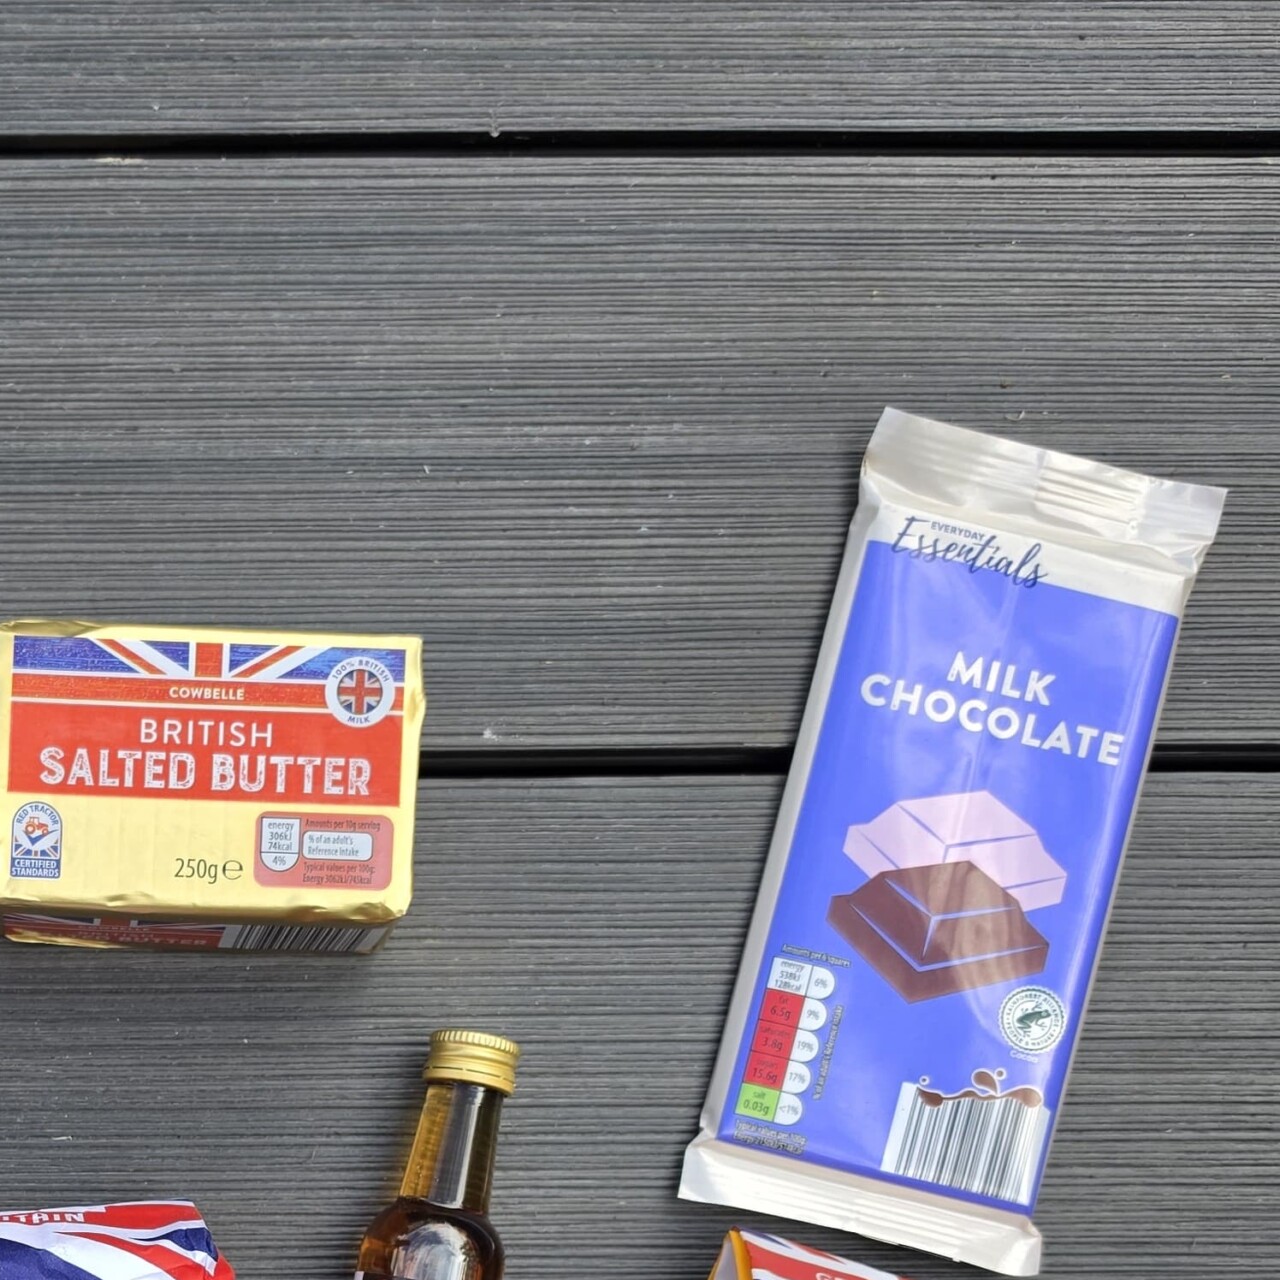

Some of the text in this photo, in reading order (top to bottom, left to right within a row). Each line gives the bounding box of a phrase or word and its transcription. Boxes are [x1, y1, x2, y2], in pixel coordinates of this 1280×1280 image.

[930, 521, 985, 542] EVERYDAY
[890, 516, 1048, 588] Essentials
[332, 660, 390, 682] 100% BRITISH
[947, 650, 1056, 706] MILK
[169, 685, 245, 701] COWBELLE
[348, 716, 370, 724] MILK
[860, 673, 1125, 766] CHOCOLATE
[140, 719, 273, 748] BRITISH
[39, 746, 372, 797] SALTED BUTTER
[16, 804, 59, 826] RED TRACTOR
[268, 820, 294, 831] energy
[269, 831, 292, 841] 306kJ
[268, 841, 293, 851] 74kcal
[15, 859, 57, 869] CERTIFIED
[272, 856, 286, 866] 4%
[12, 868, 59, 877] STANDARDS
[174, 858, 218, 885] 250g
[770, 1005, 791, 1020] 6.5g
[762, 1037, 783, 1052] 3.8g
[752, 1067, 778, 1084] 15.6g
[743, 1099, 770, 1116] 0.03g
